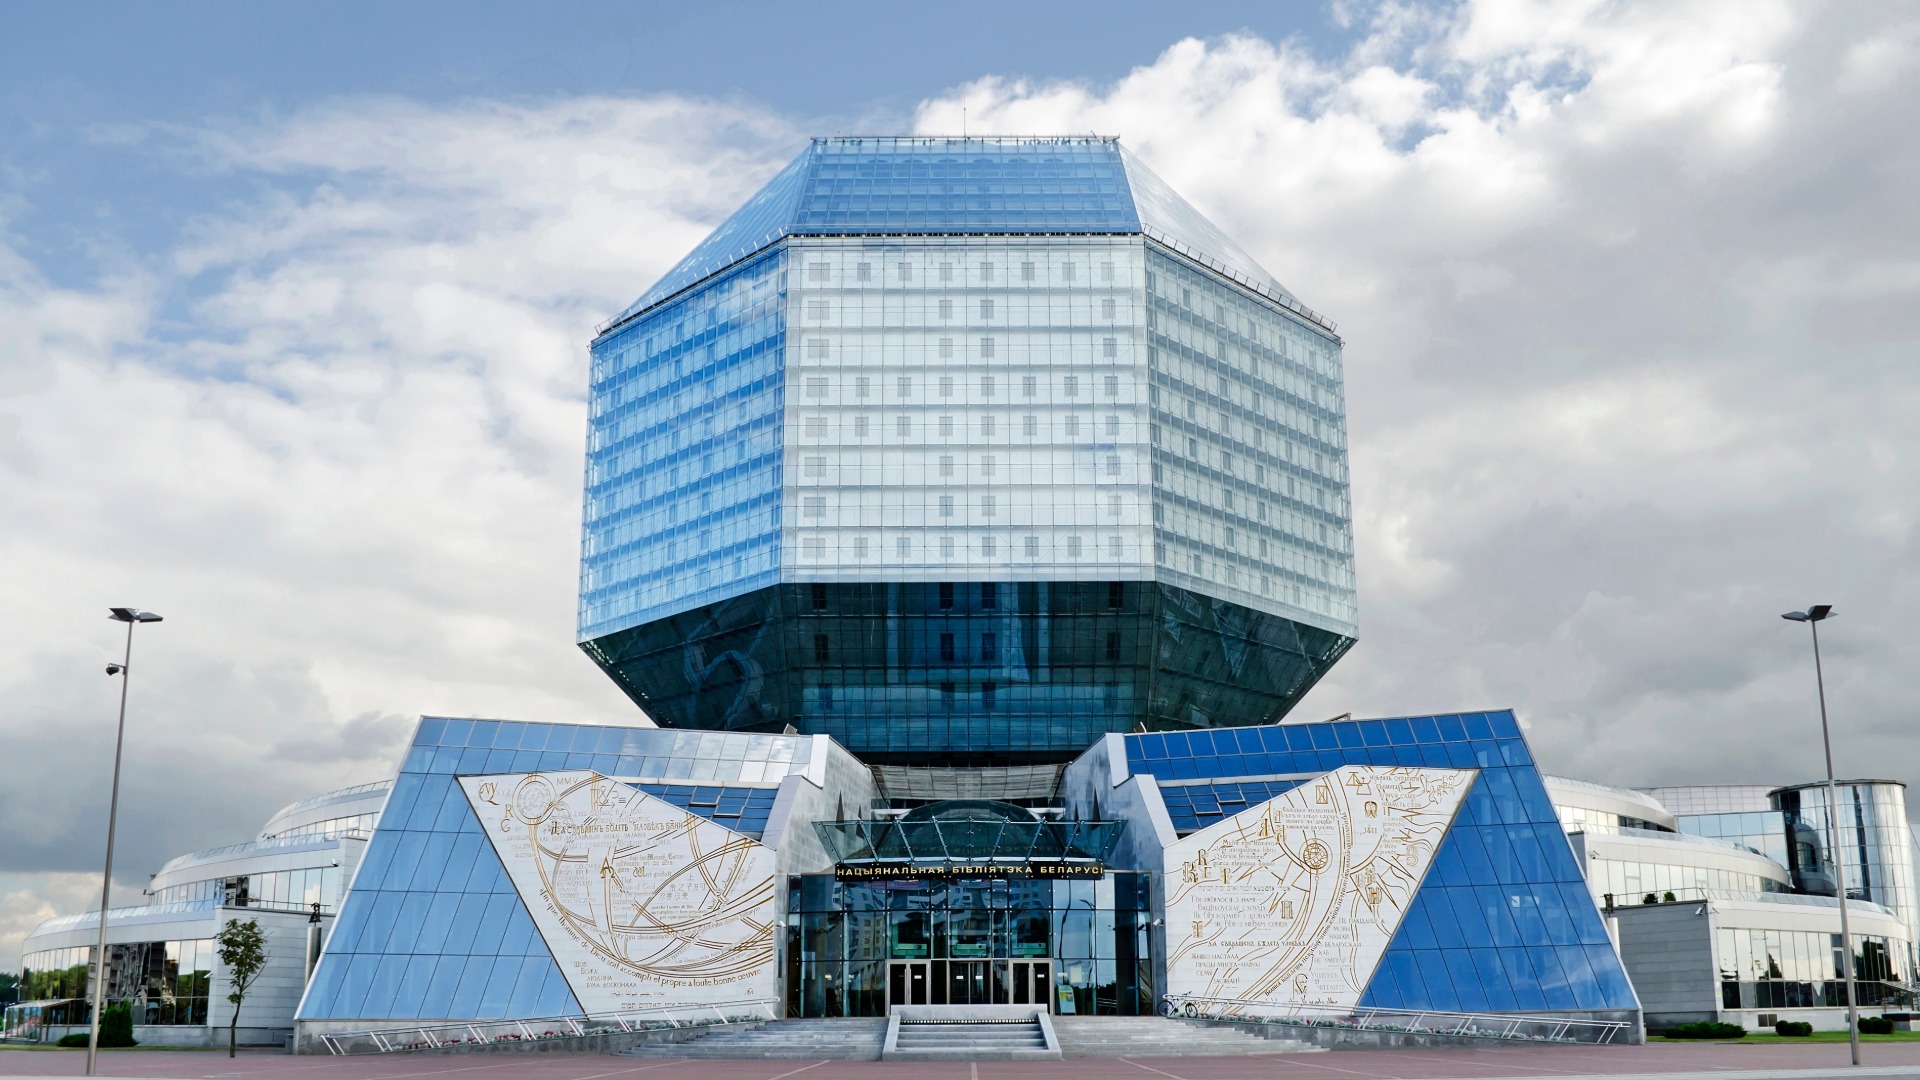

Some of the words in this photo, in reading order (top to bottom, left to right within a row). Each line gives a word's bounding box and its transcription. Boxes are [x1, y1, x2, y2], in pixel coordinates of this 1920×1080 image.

[836, 866, 945, 877] НАЦЫЯНАЛЬНАЯ
[952, 865, 1033, 875] БІБЛІЯТЭКА
[1040, 865, 1103, 875] БЕЛАРУСІ
[713, 976, 736, 986] bonne
